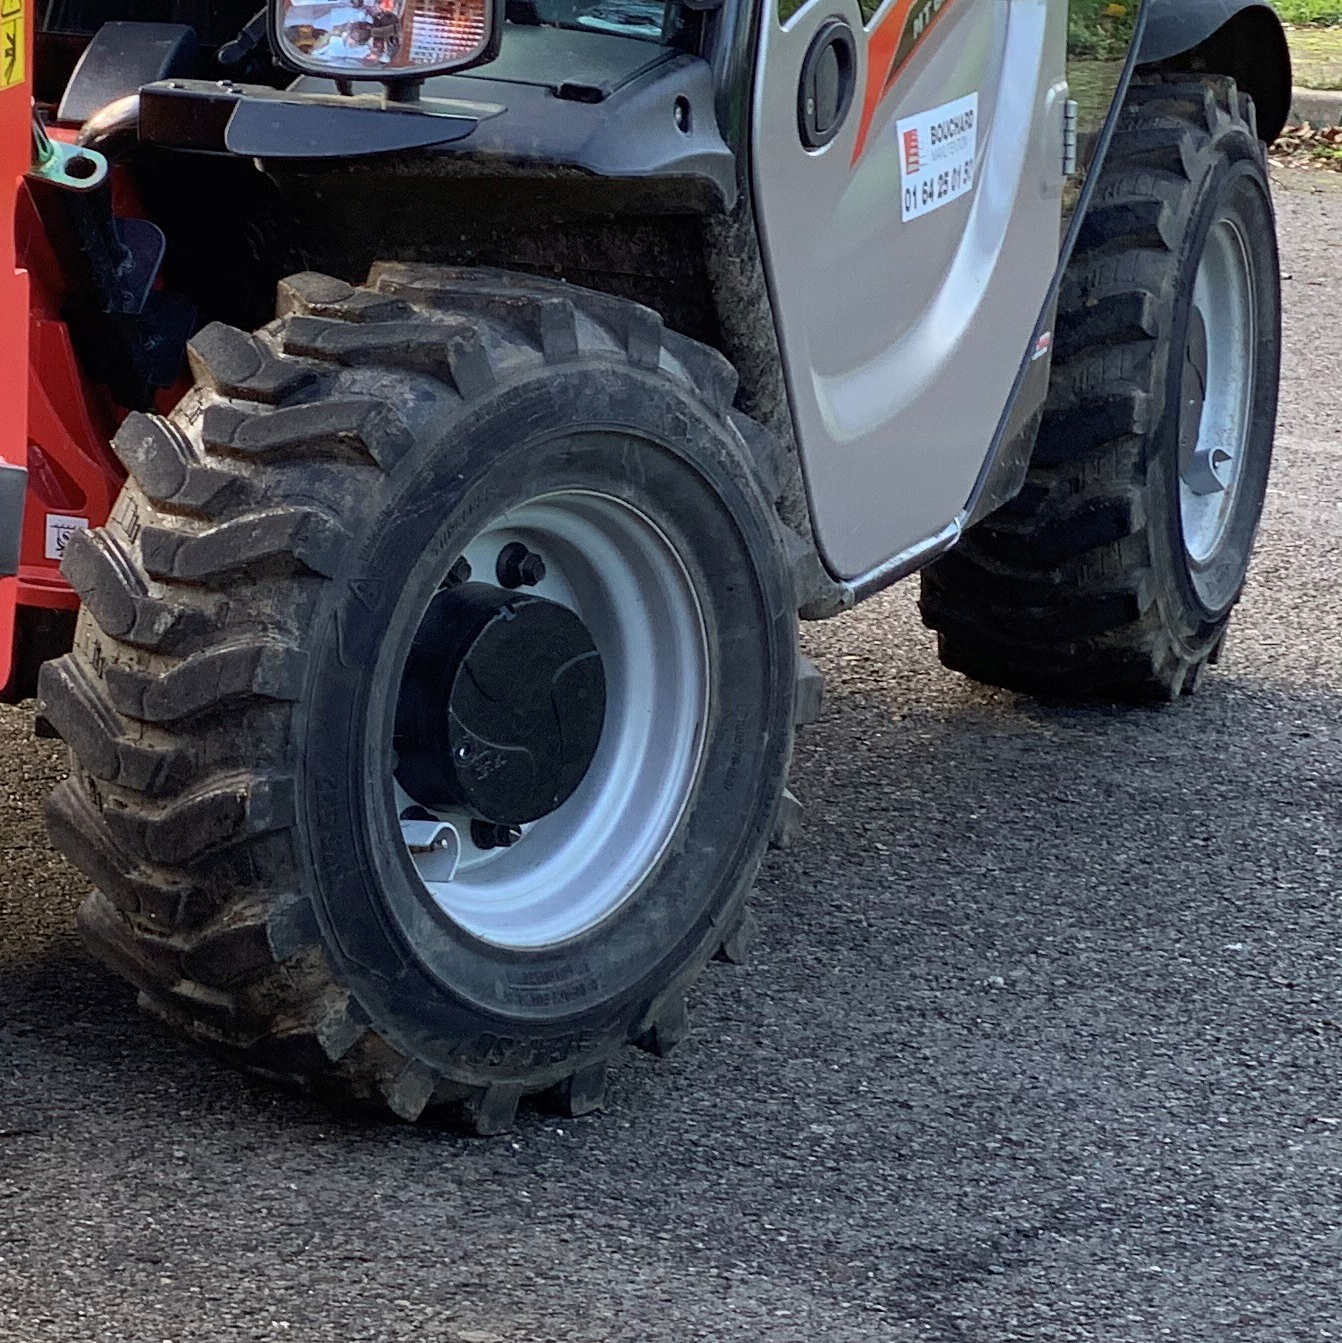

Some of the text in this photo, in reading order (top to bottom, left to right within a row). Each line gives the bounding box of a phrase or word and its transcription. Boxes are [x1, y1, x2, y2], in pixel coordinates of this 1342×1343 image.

[930, 109, 974, 145] BOUCHARD
[904, 184, 917, 212] 01
[921, 177, 934, 206] 64
[937, 170, 949, 199] 25
[951, 165, 961, 192] 01
